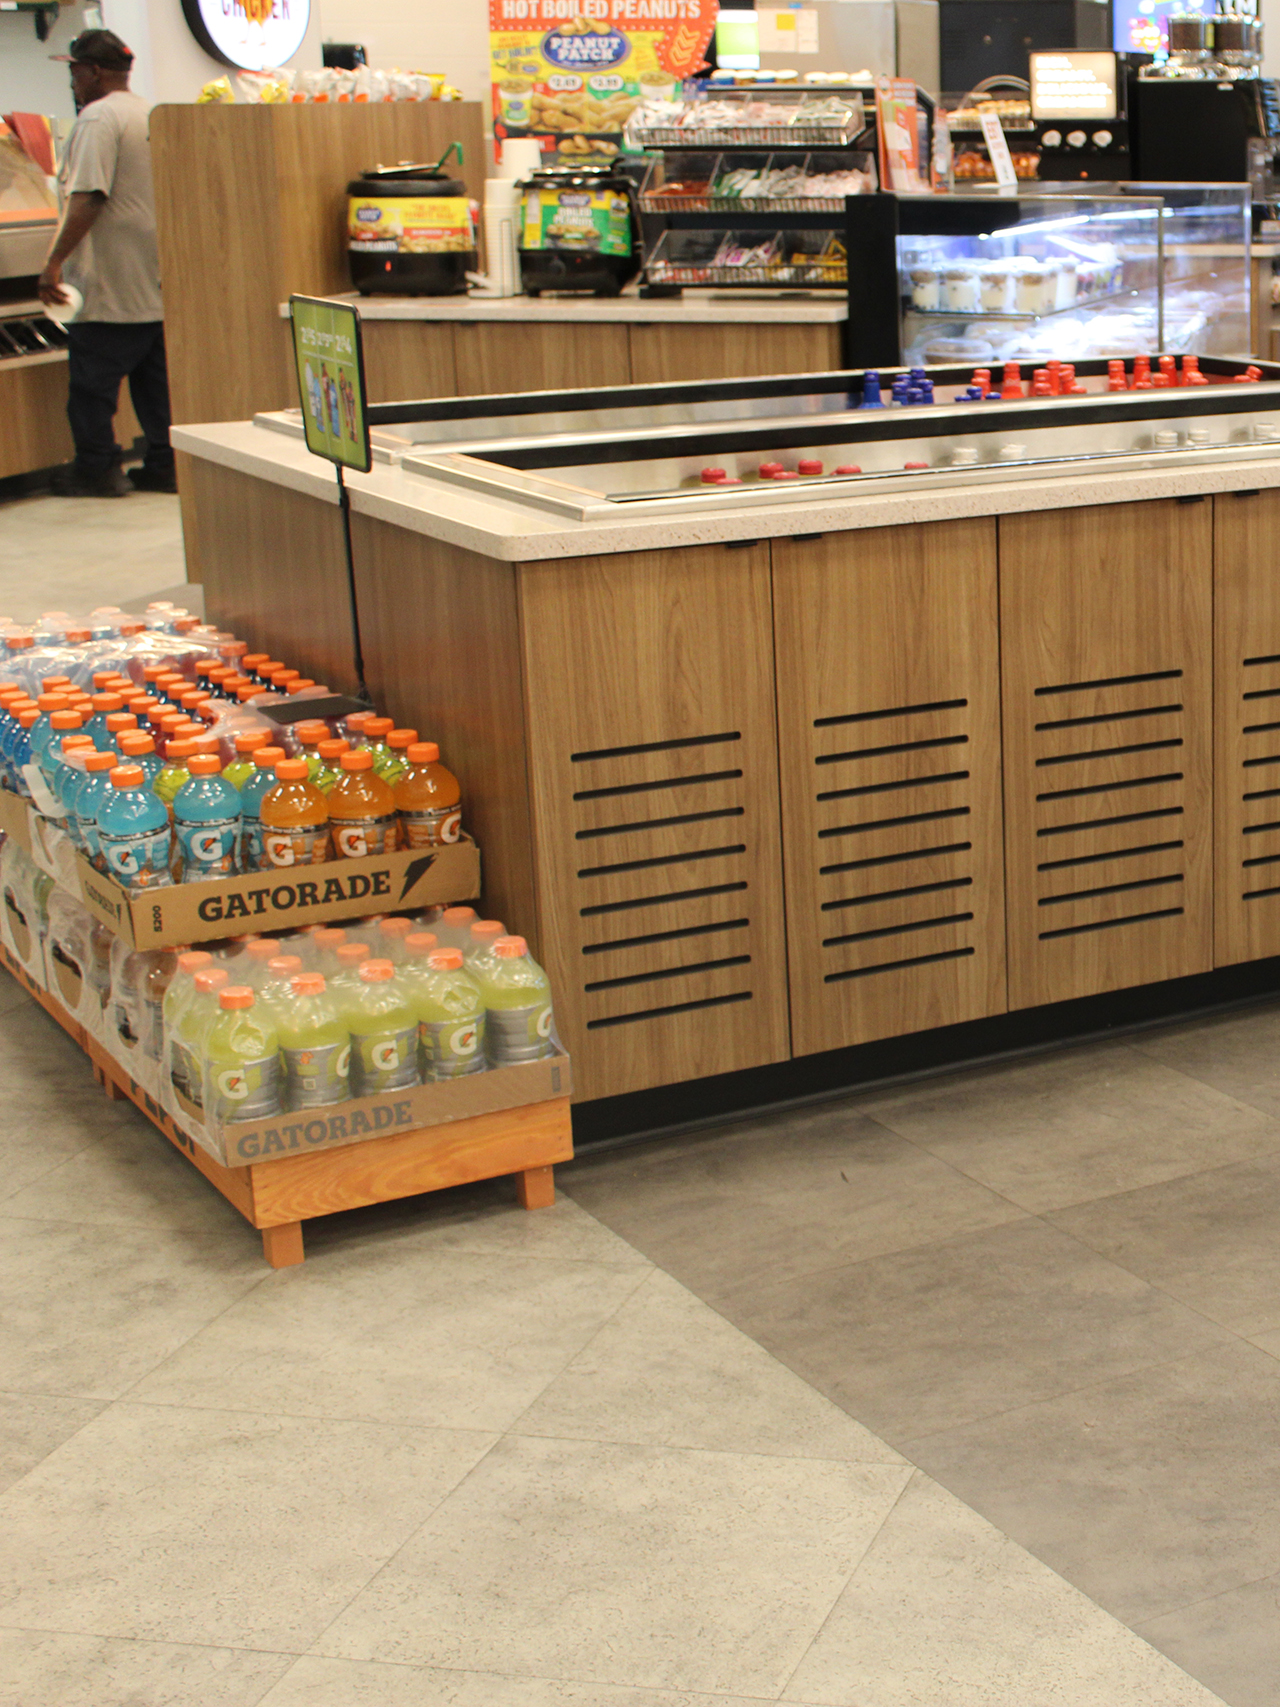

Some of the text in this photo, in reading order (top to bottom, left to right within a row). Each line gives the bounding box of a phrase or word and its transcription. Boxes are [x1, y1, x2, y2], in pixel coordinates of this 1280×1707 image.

[502, 0, 702, 19] HOT BOILED PEANUTS
[550, 36, 621, 50] PEANUT
[557, 48, 616, 61] PATCH
[198, 870, 391, 922] GATORADE
[152, 905, 163, 932] 5200
[236, 1100, 412, 1159] GATORADE
